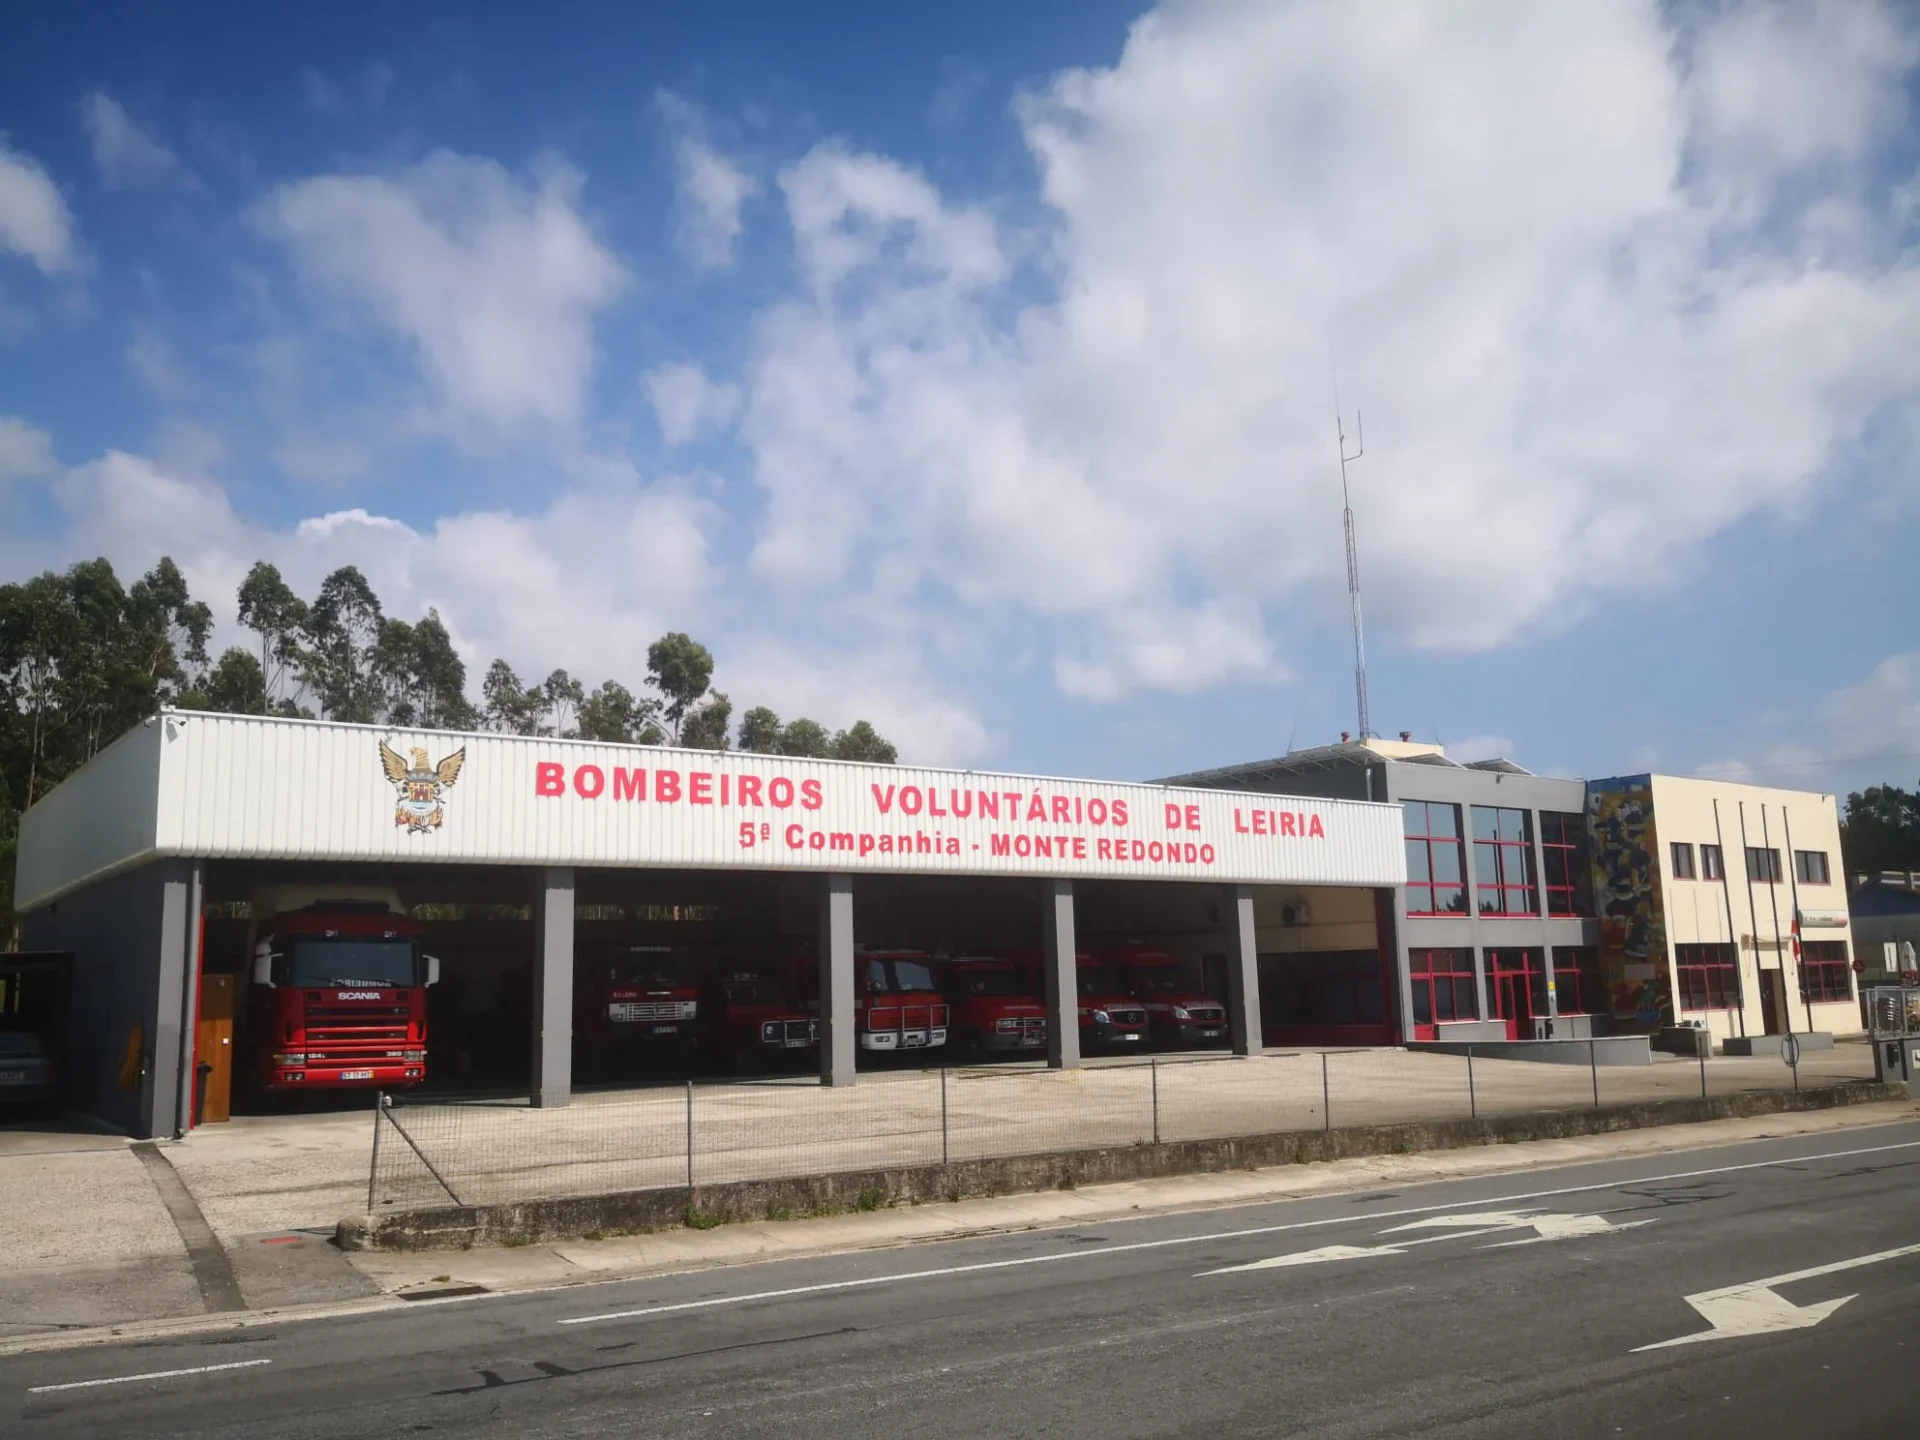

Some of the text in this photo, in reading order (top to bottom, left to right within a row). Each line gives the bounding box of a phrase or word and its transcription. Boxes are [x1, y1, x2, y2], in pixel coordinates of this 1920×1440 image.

[536, 762, 1324, 838] BOMBEIROS VOLUNTÁRIOS DE LEIRIA
[785, 824, 960, 857] Companhia
[991, 833, 1086, 860] MONTE
[1097, 838, 1216, 864] REDONDO
[338, 992, 381, 1000] SCANIA
